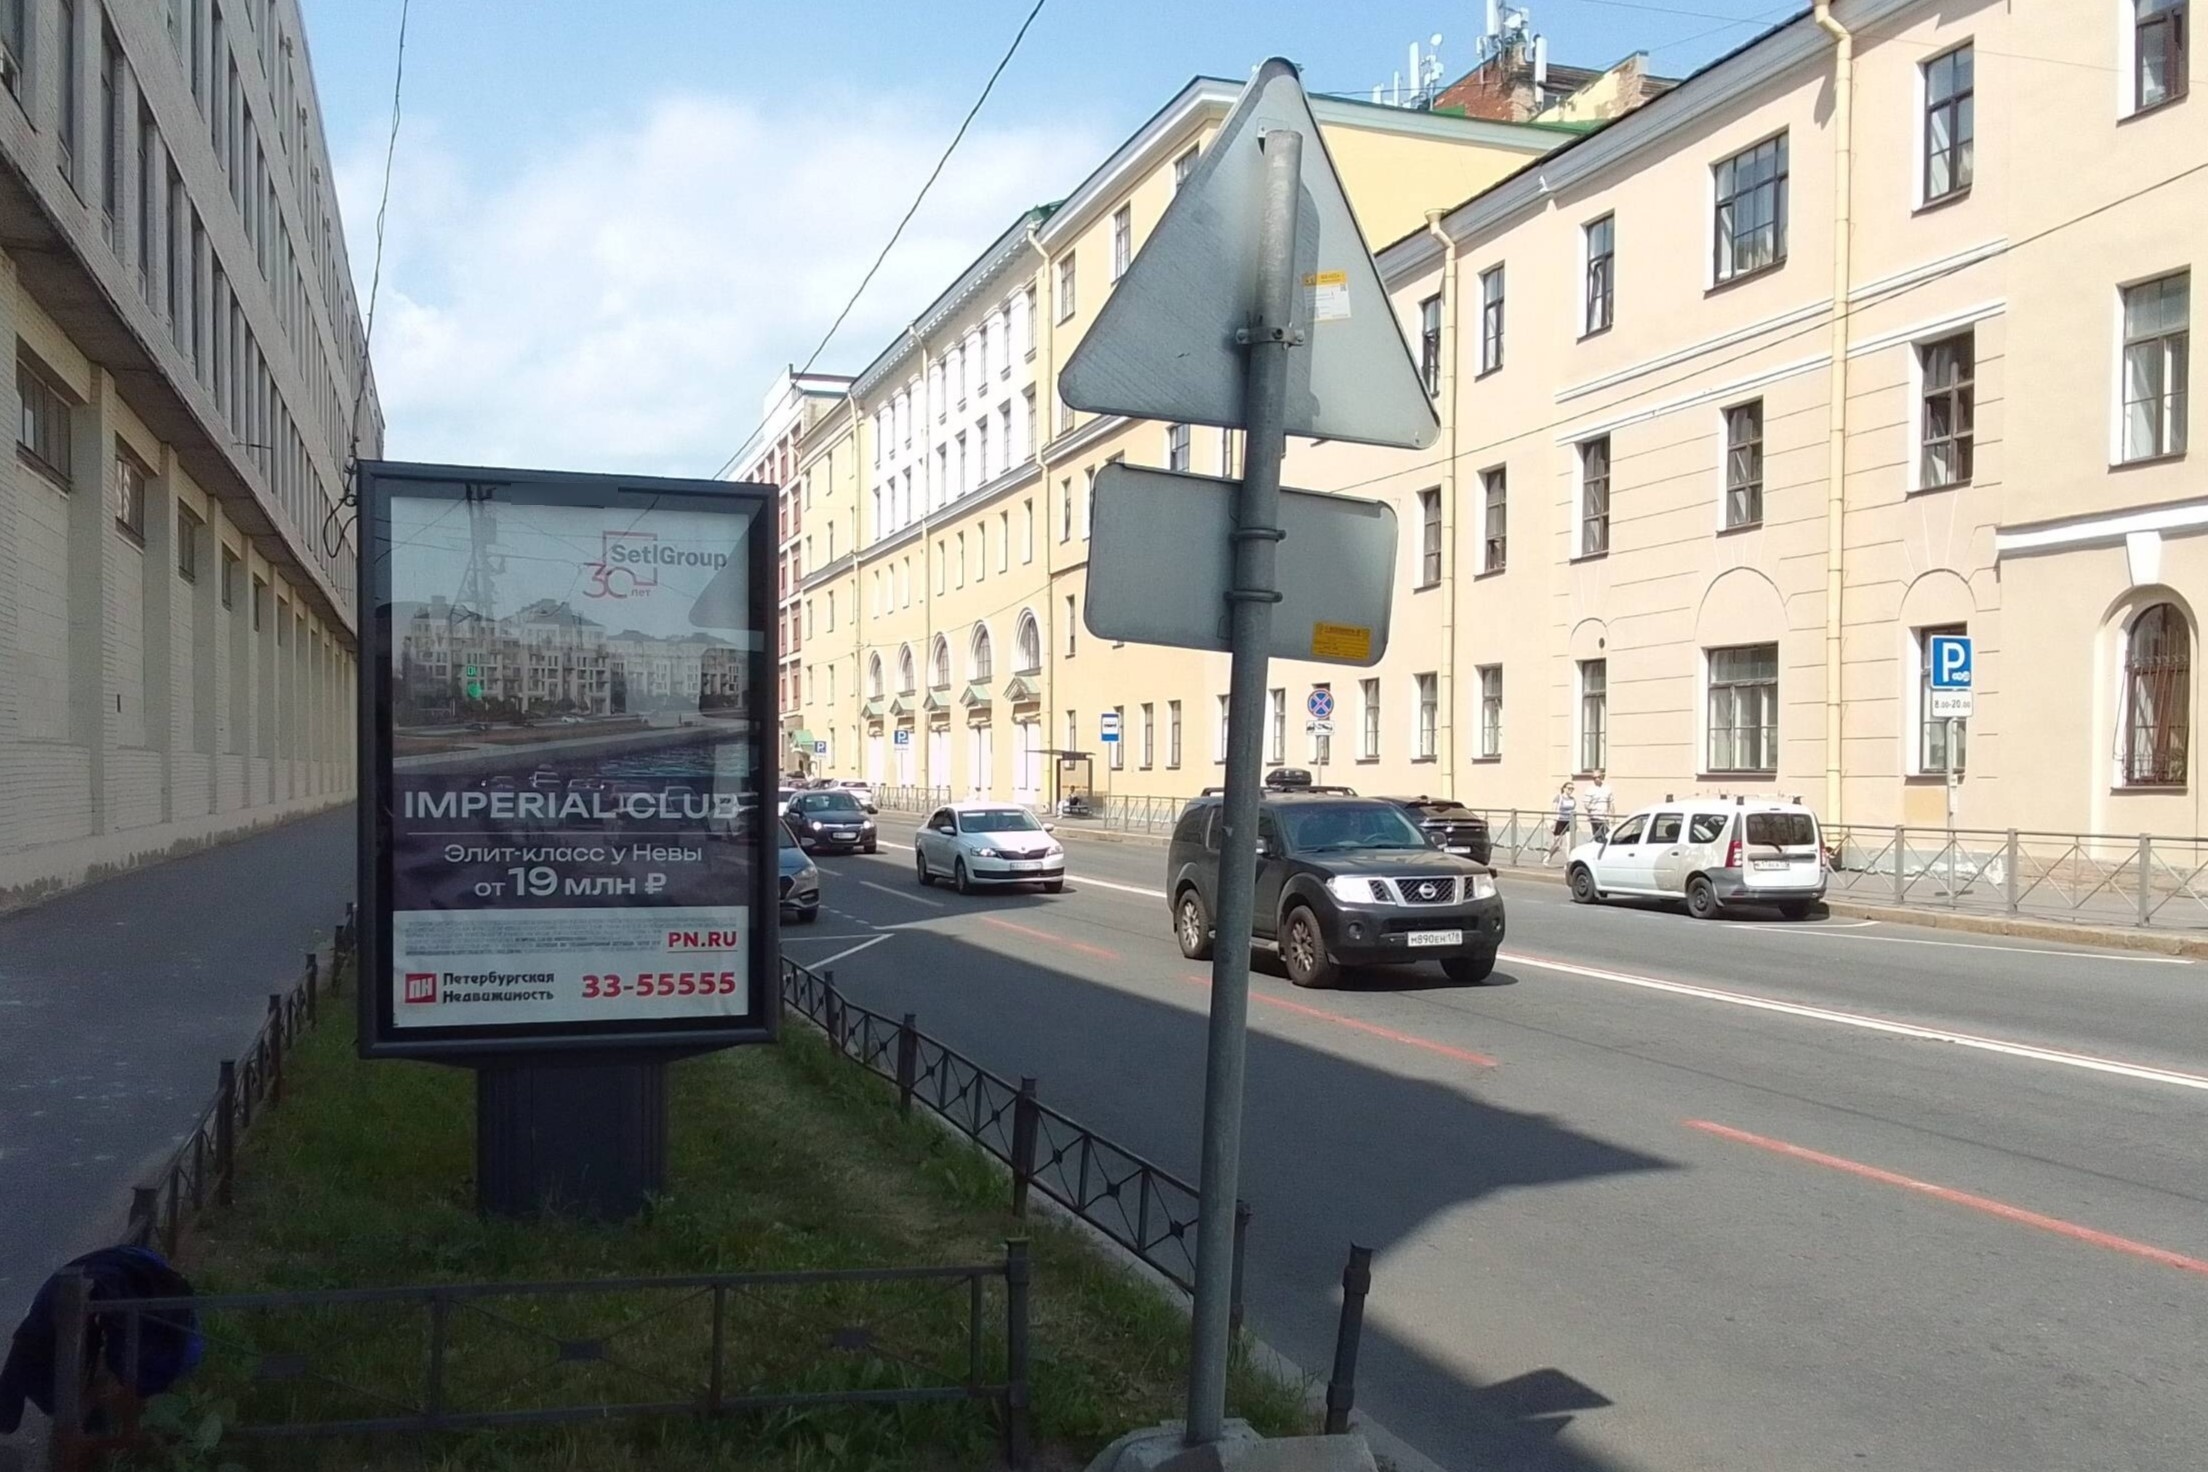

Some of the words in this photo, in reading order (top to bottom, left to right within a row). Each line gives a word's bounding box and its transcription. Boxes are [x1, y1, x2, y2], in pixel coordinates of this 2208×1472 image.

[631, 588, 652, 598] лет
[404, 791, 617, 819] IMPERIAL
[626, 792, 739, 819] CLUB
[444, 844, 606, 863] Элит-класс
[610, 847, 627, 866] у
[632, 843, 703, 862] Невы
[474, 881, 507, 897] от
[507, 866, 559, 897] 19
[564, 877, 637, 896] млн
[667, 931, 737, 948] PN.RU
[442, 971, 555, 987] Петербургская
[581, 971, 737, 999] 33-55555
[442, 990, 555, 1004] Недвижимость
